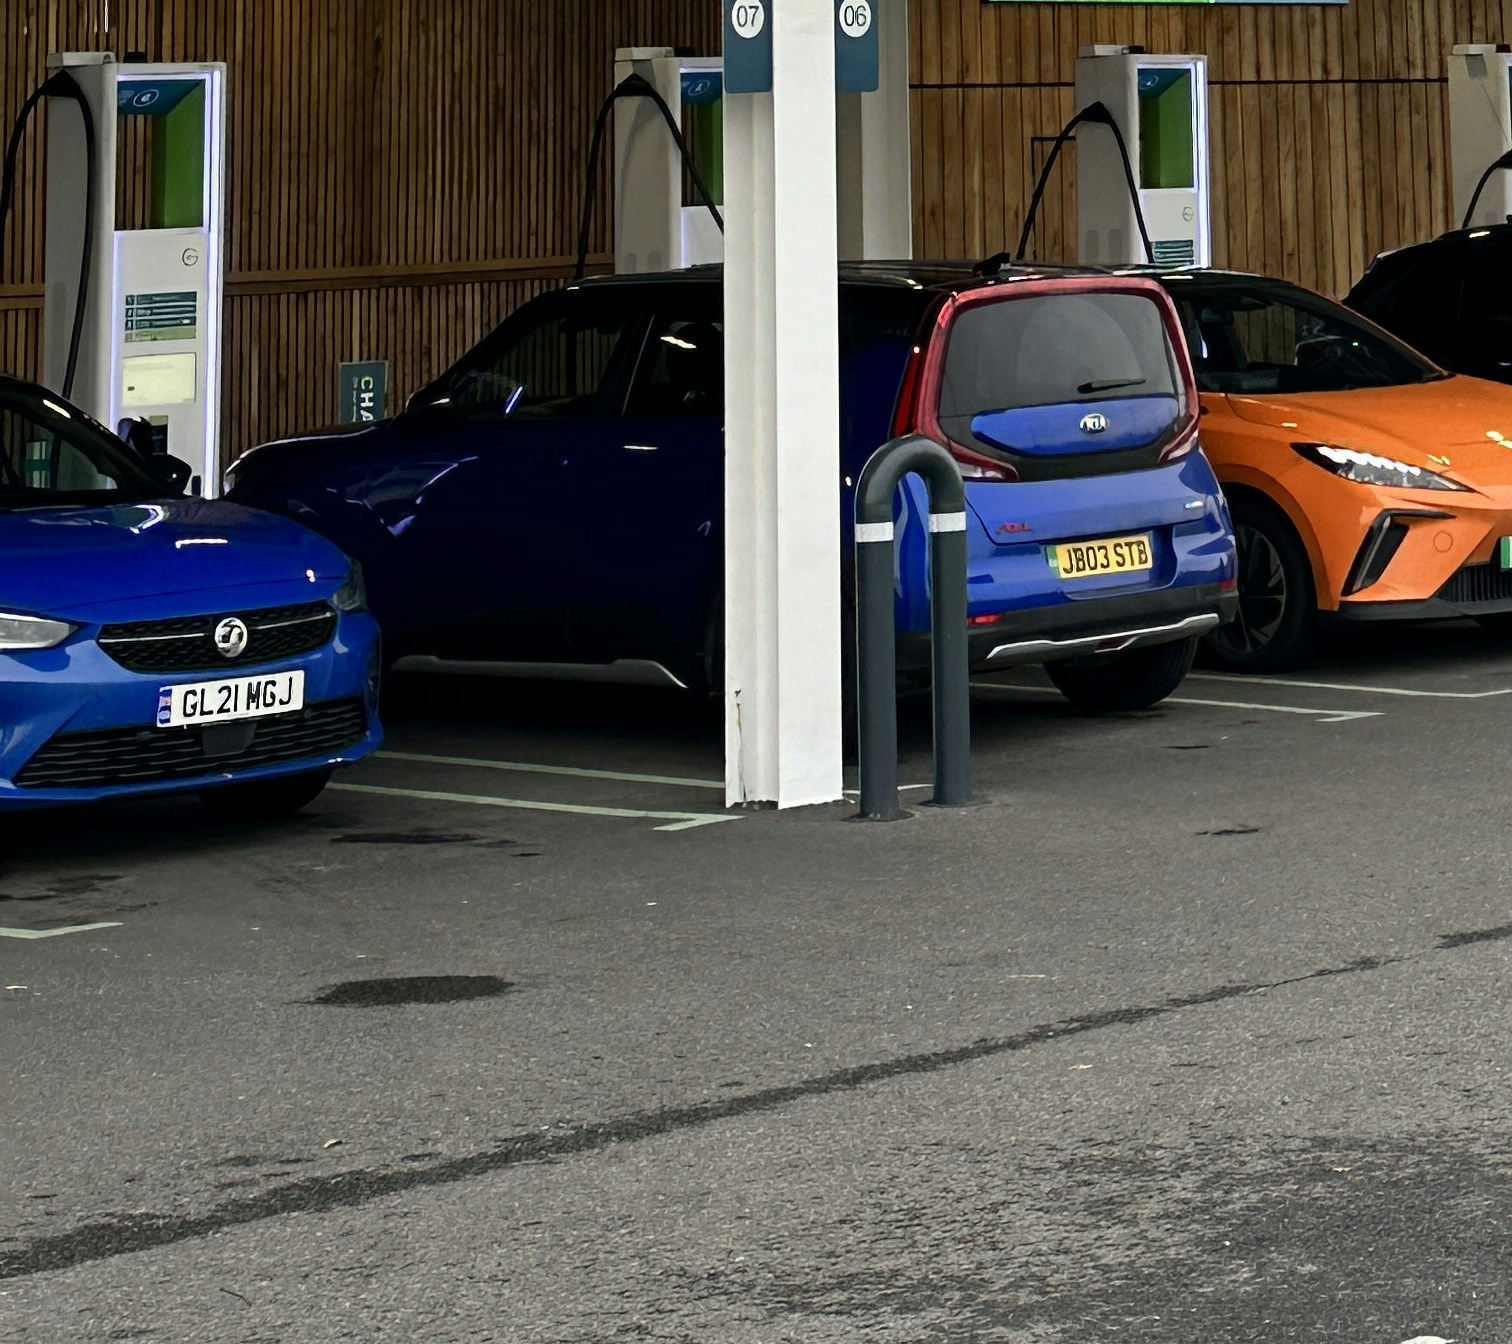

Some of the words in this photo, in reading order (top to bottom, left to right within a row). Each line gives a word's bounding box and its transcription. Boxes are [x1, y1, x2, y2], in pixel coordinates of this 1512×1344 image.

[736, 5, 760, 28] 07
[843, 5, 867, 27] 06
[1113, 540, 1148, 568] STB
[182, 684, 238, 719] GL21
[246, 676, 293, 710] MGJ
